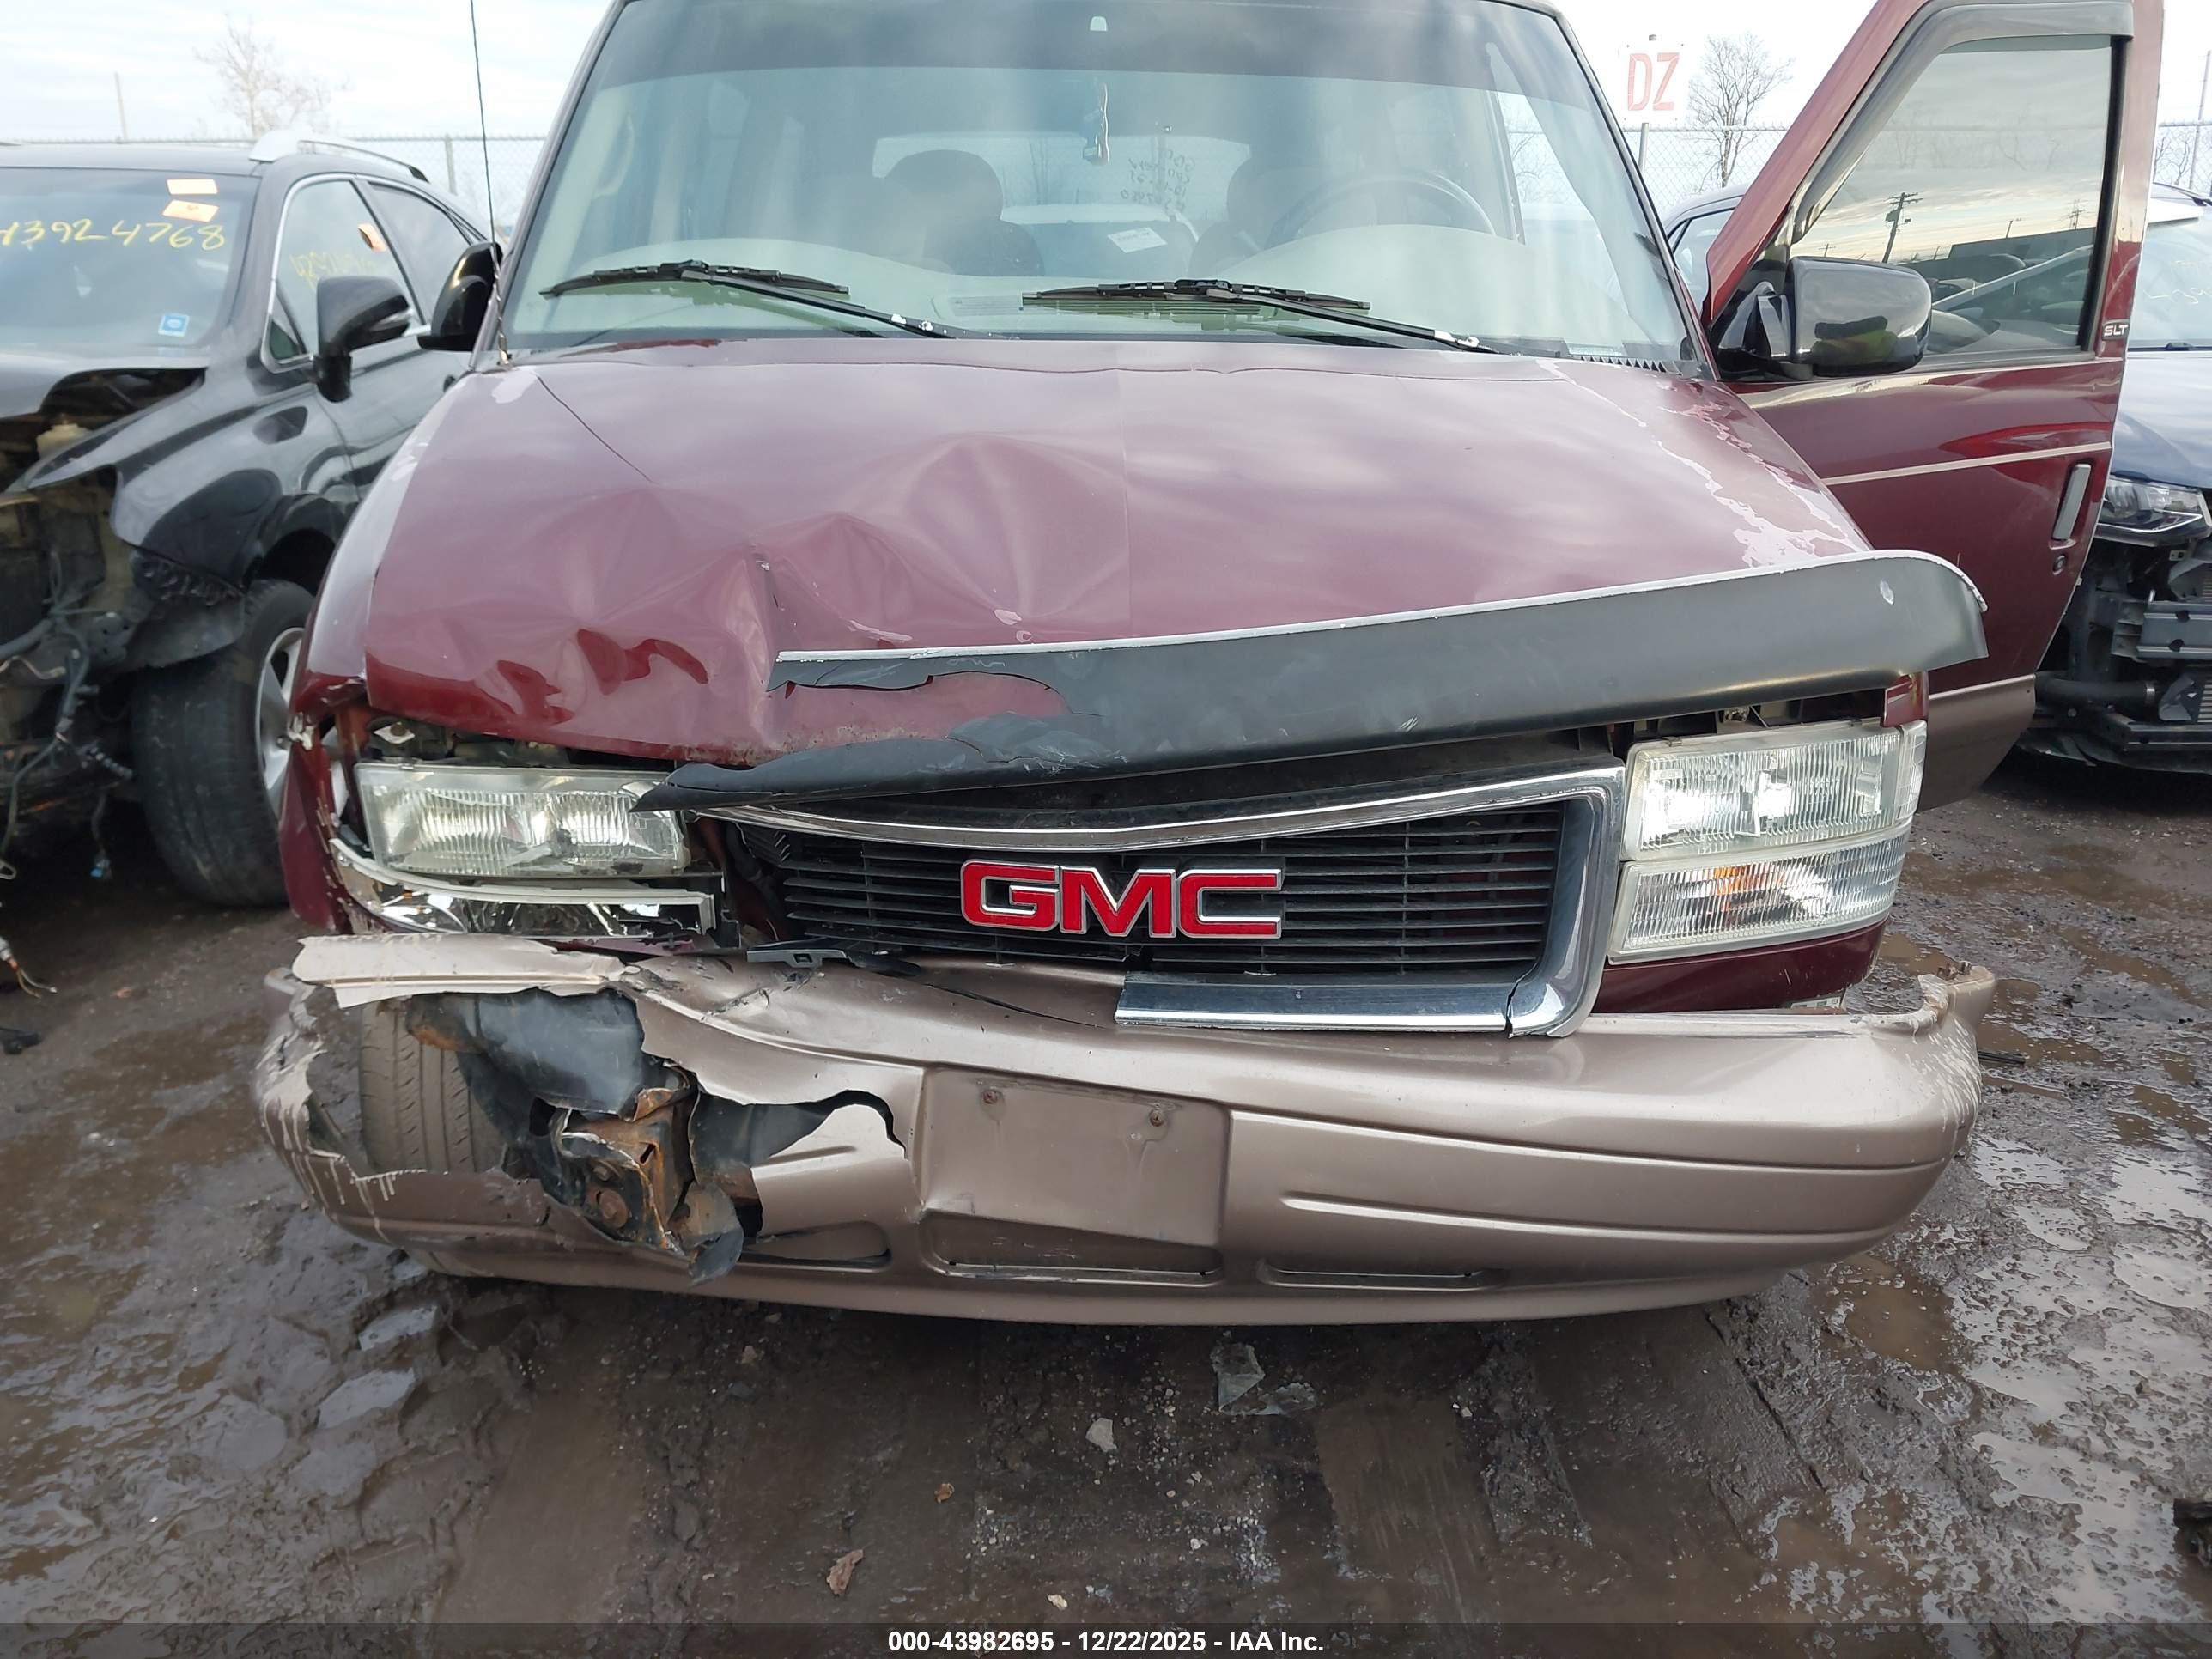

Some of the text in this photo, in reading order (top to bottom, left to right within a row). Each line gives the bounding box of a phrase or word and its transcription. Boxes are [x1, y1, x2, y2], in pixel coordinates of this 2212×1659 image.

[1627, 52, 1680, 111] DZ
[2103, 324, 2129, 337] SLT
[961, 859, 1283, 939] GMC
